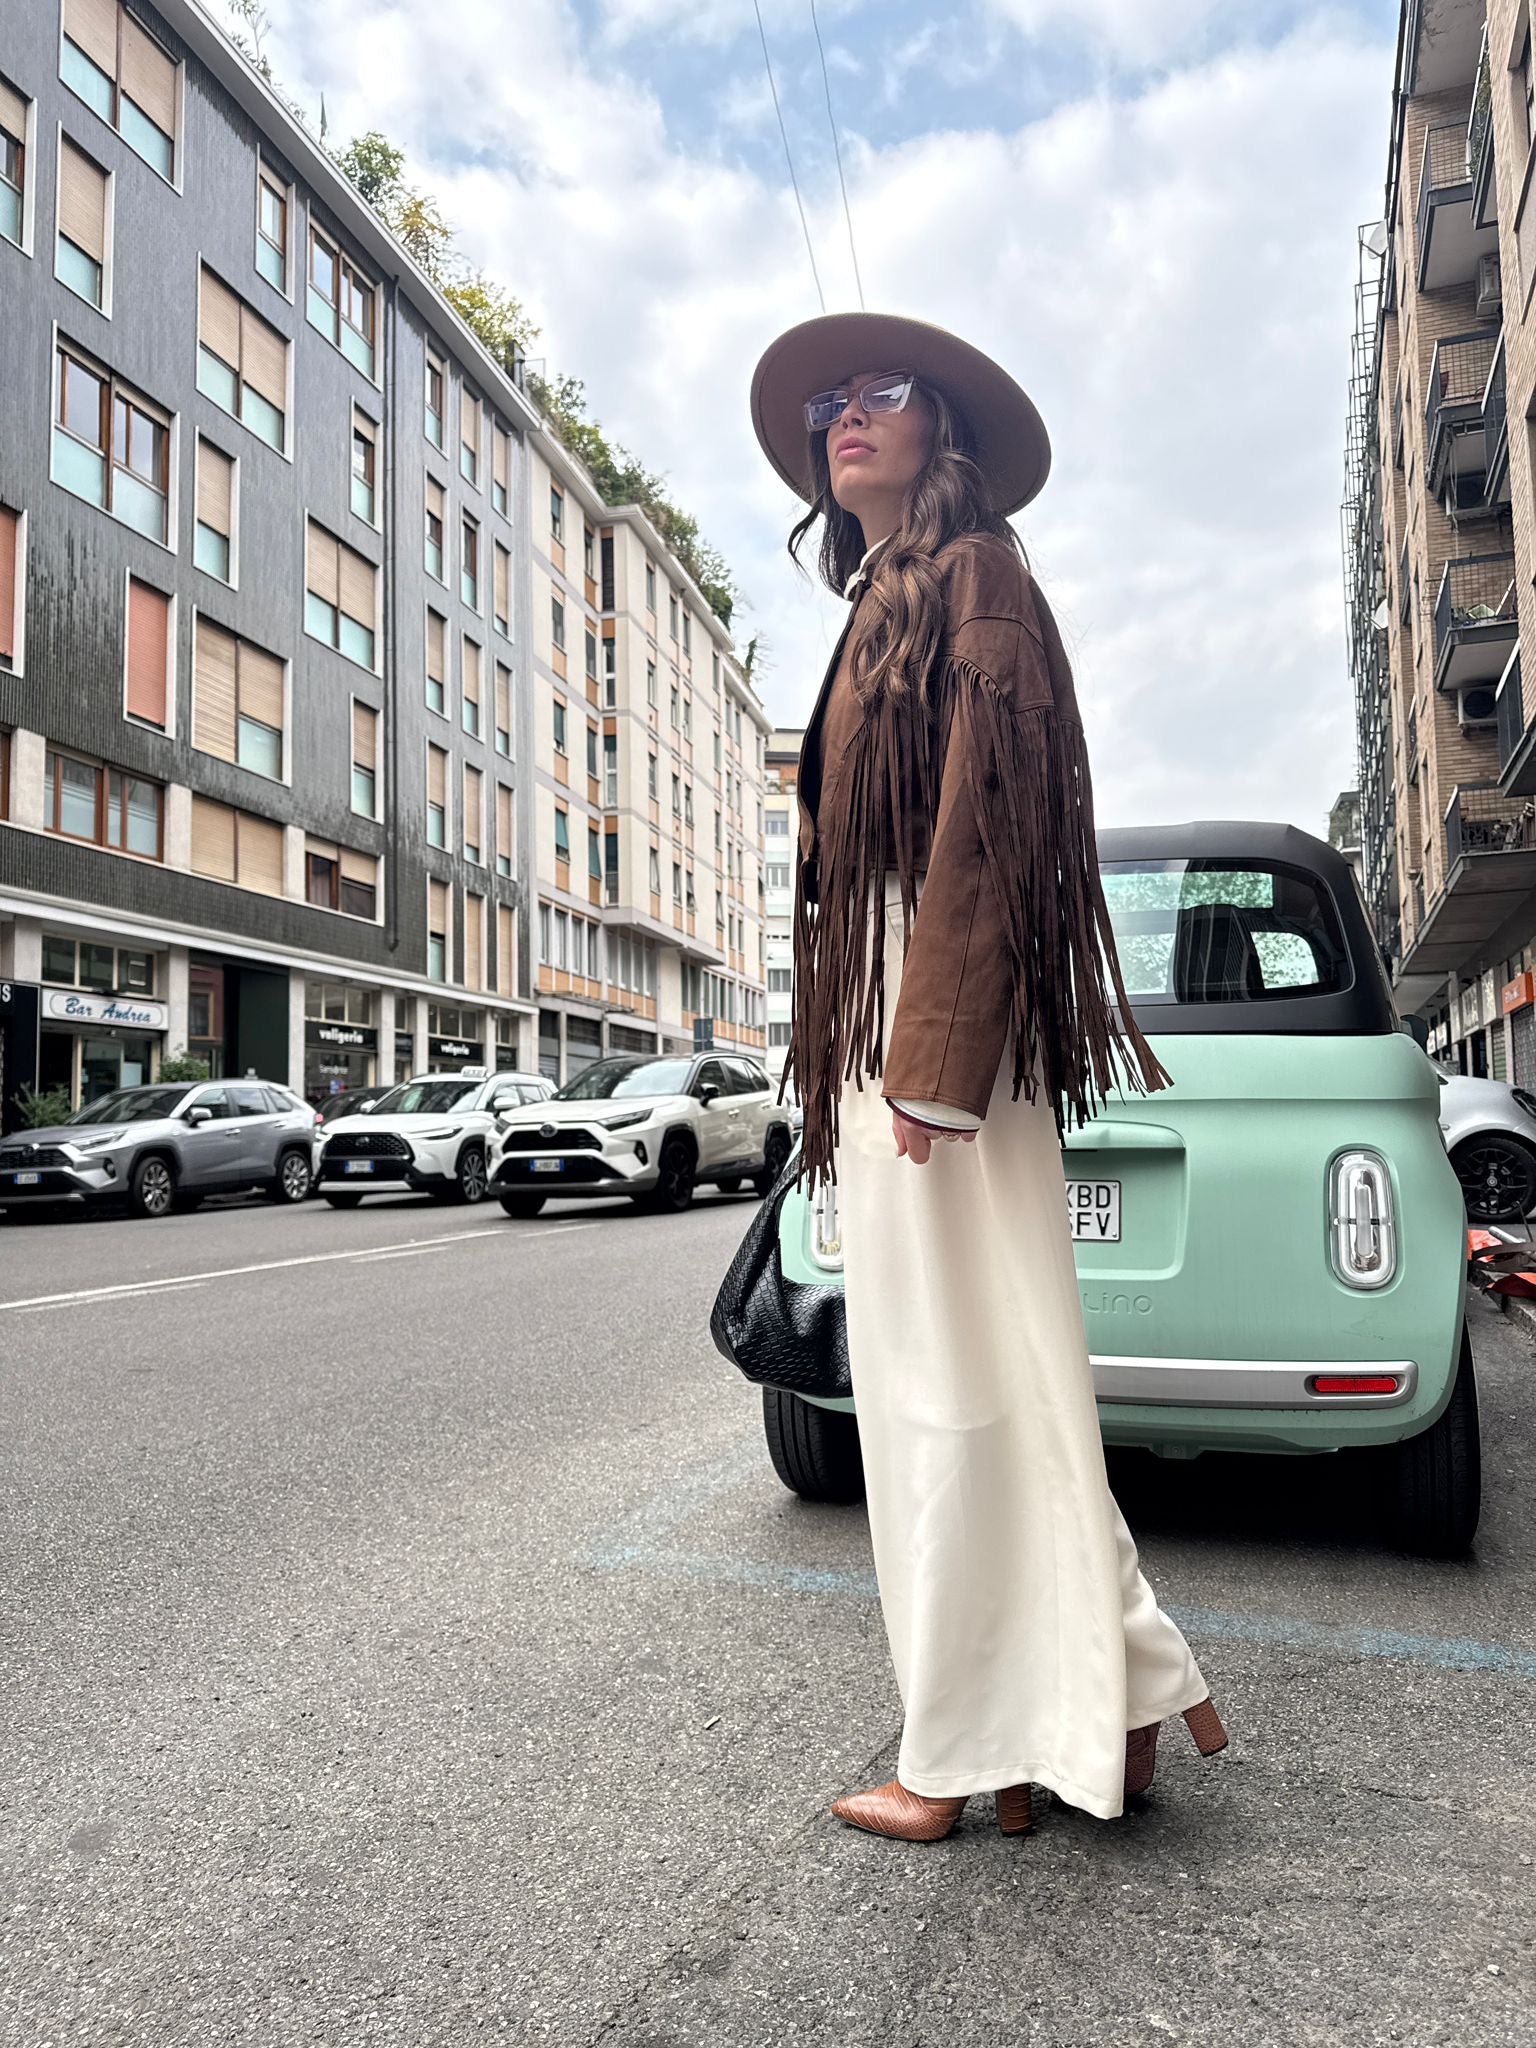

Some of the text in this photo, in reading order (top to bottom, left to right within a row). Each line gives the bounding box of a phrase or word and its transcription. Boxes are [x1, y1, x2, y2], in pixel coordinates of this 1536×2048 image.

[65, 996, 152, 1024] Bar Andrea
[319, 1027, 364, 1045] valigeria
[1069, 1211, 1111, 1236] FV
